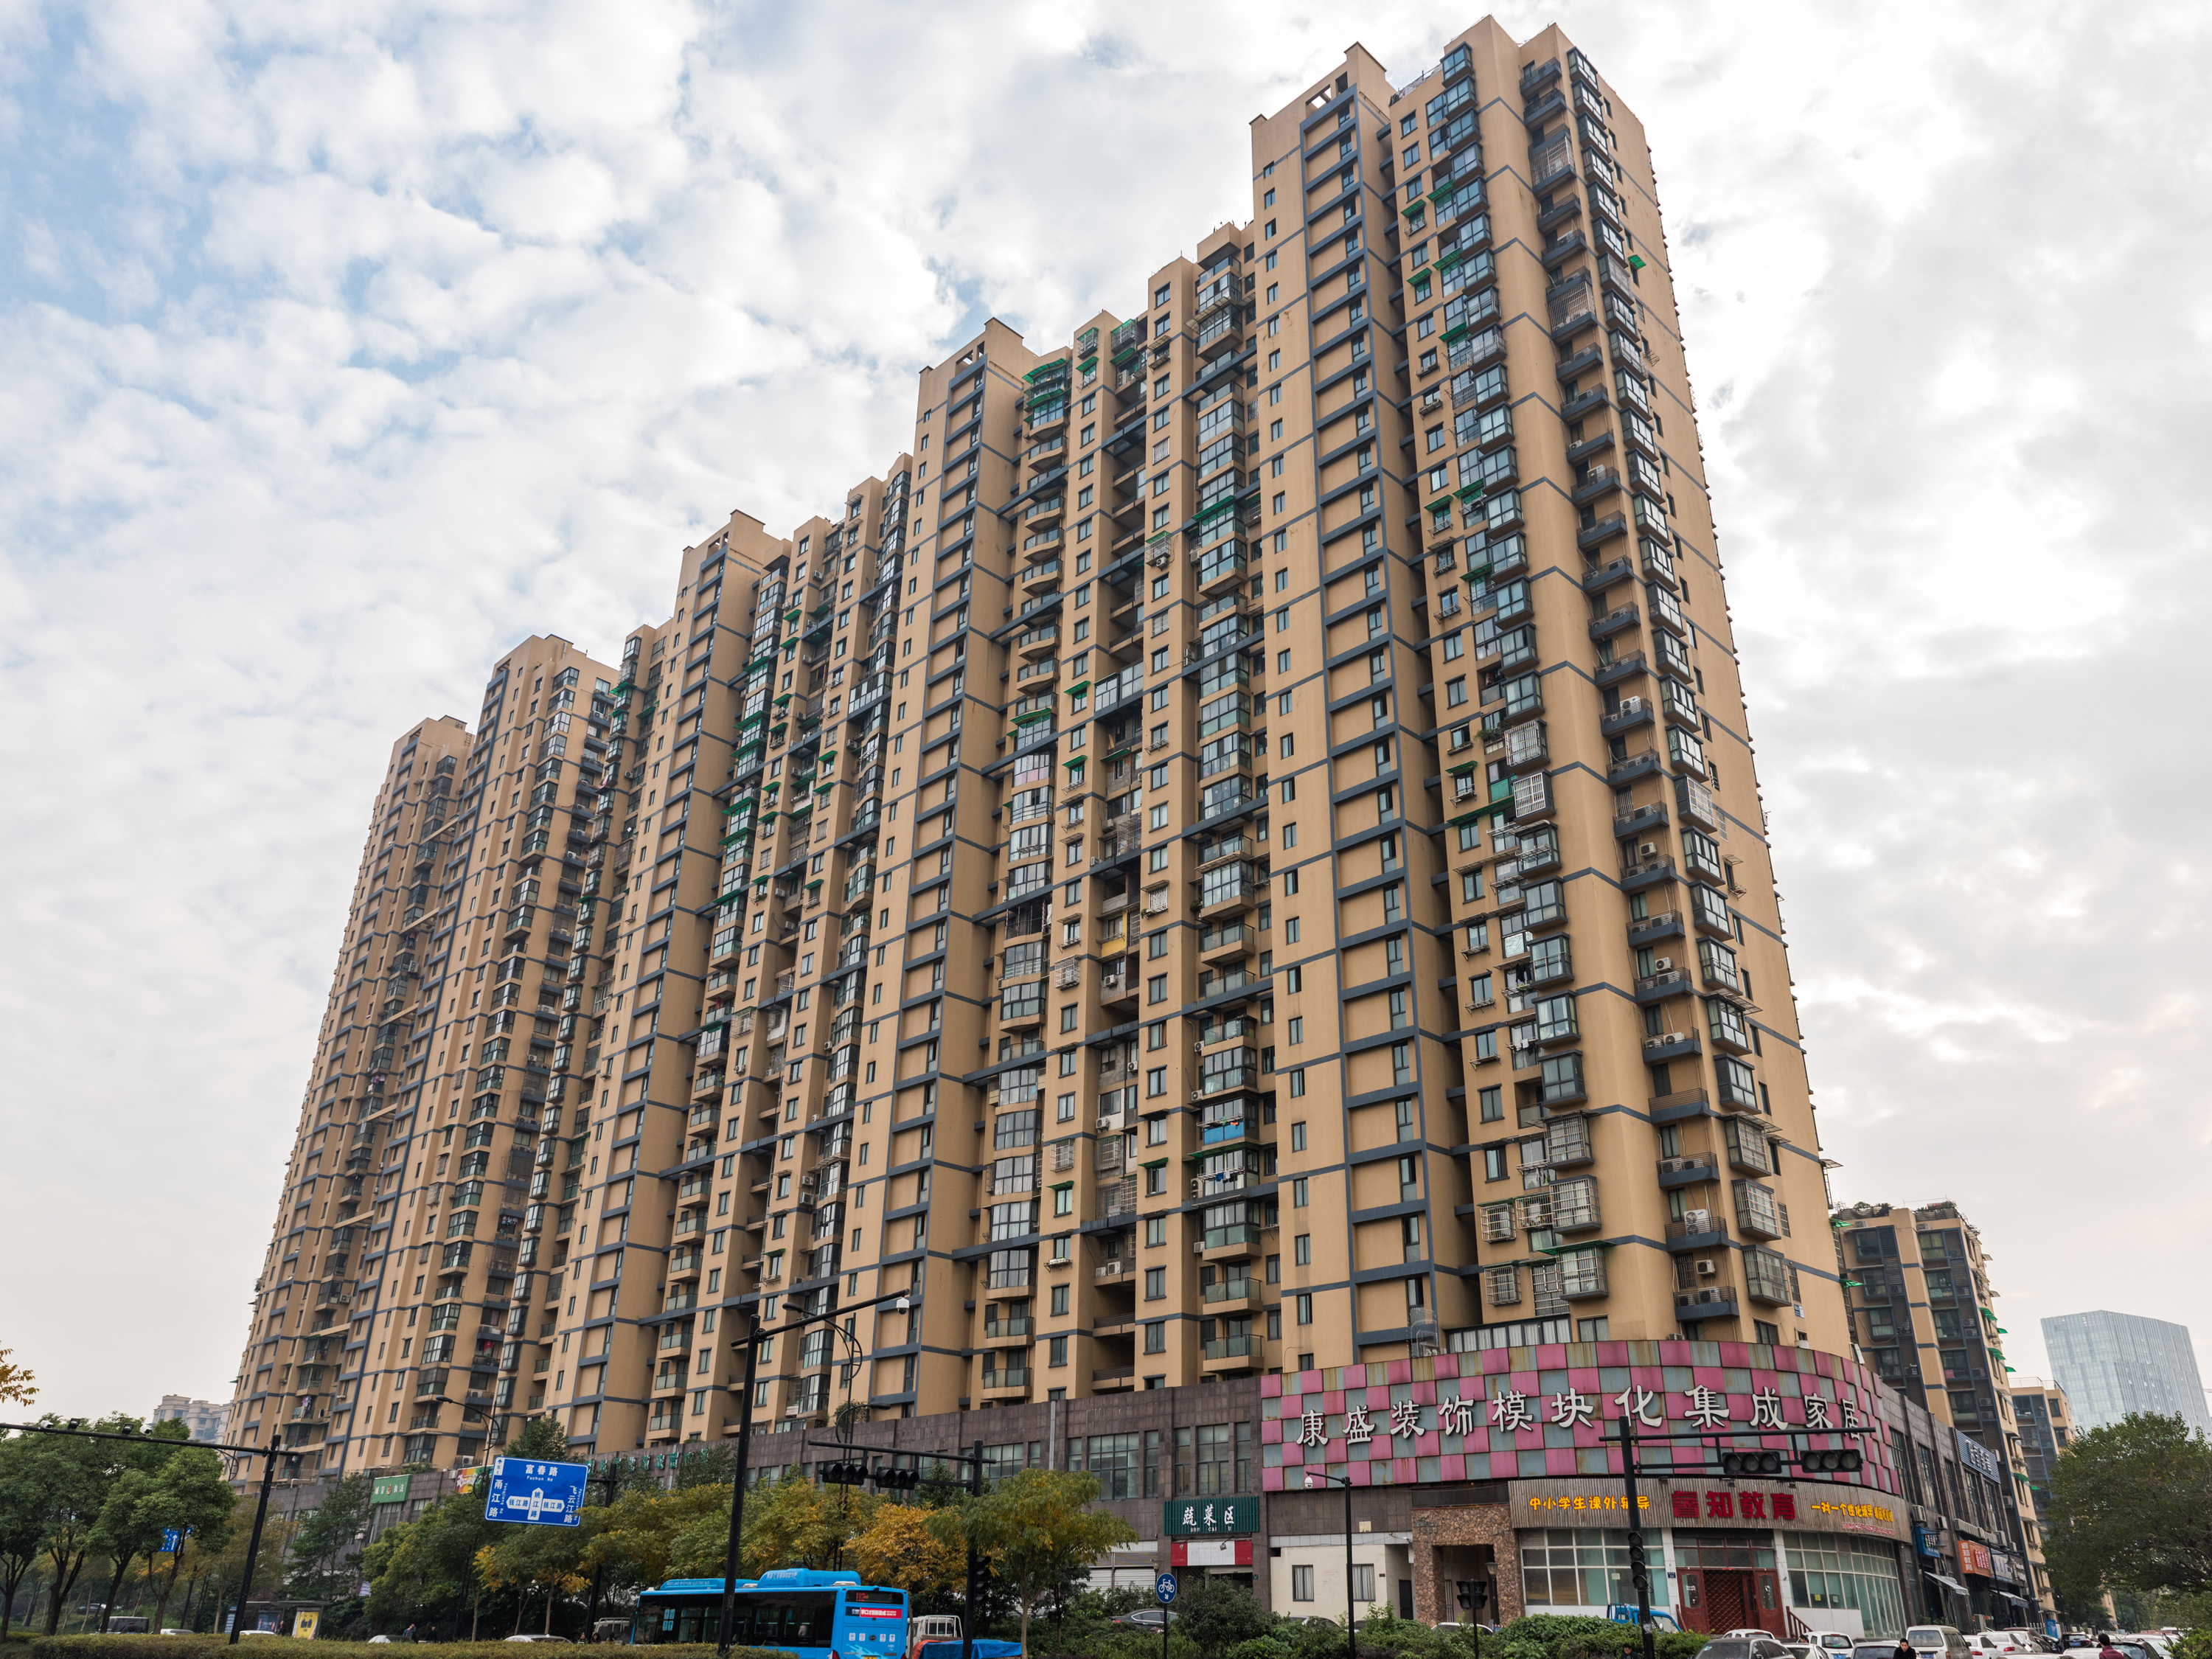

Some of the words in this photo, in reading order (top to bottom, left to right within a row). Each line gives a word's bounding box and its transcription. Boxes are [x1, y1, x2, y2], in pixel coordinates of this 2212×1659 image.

[1296, 1384, 1860, 1447] 康盛装饰模块化集成家居
[525, 1464, 558, 1476] 富春路
[488, 1479, 503, 1517] 甬江路
[509, 1498, 529, 1507] 钱江路
[530, 1491, 540, 1517] 姚江路
[543, 1501, 563, 1510] 钱江路
[563, 1485, 577, 1523] 飞云江路
[1529, 1495, 1650, 1511] 中小学生课外辅导
[1672, 1491, 1796, 1520] 睿知教育
[1183, 1503, 1235, 1527] 蔬菜区
